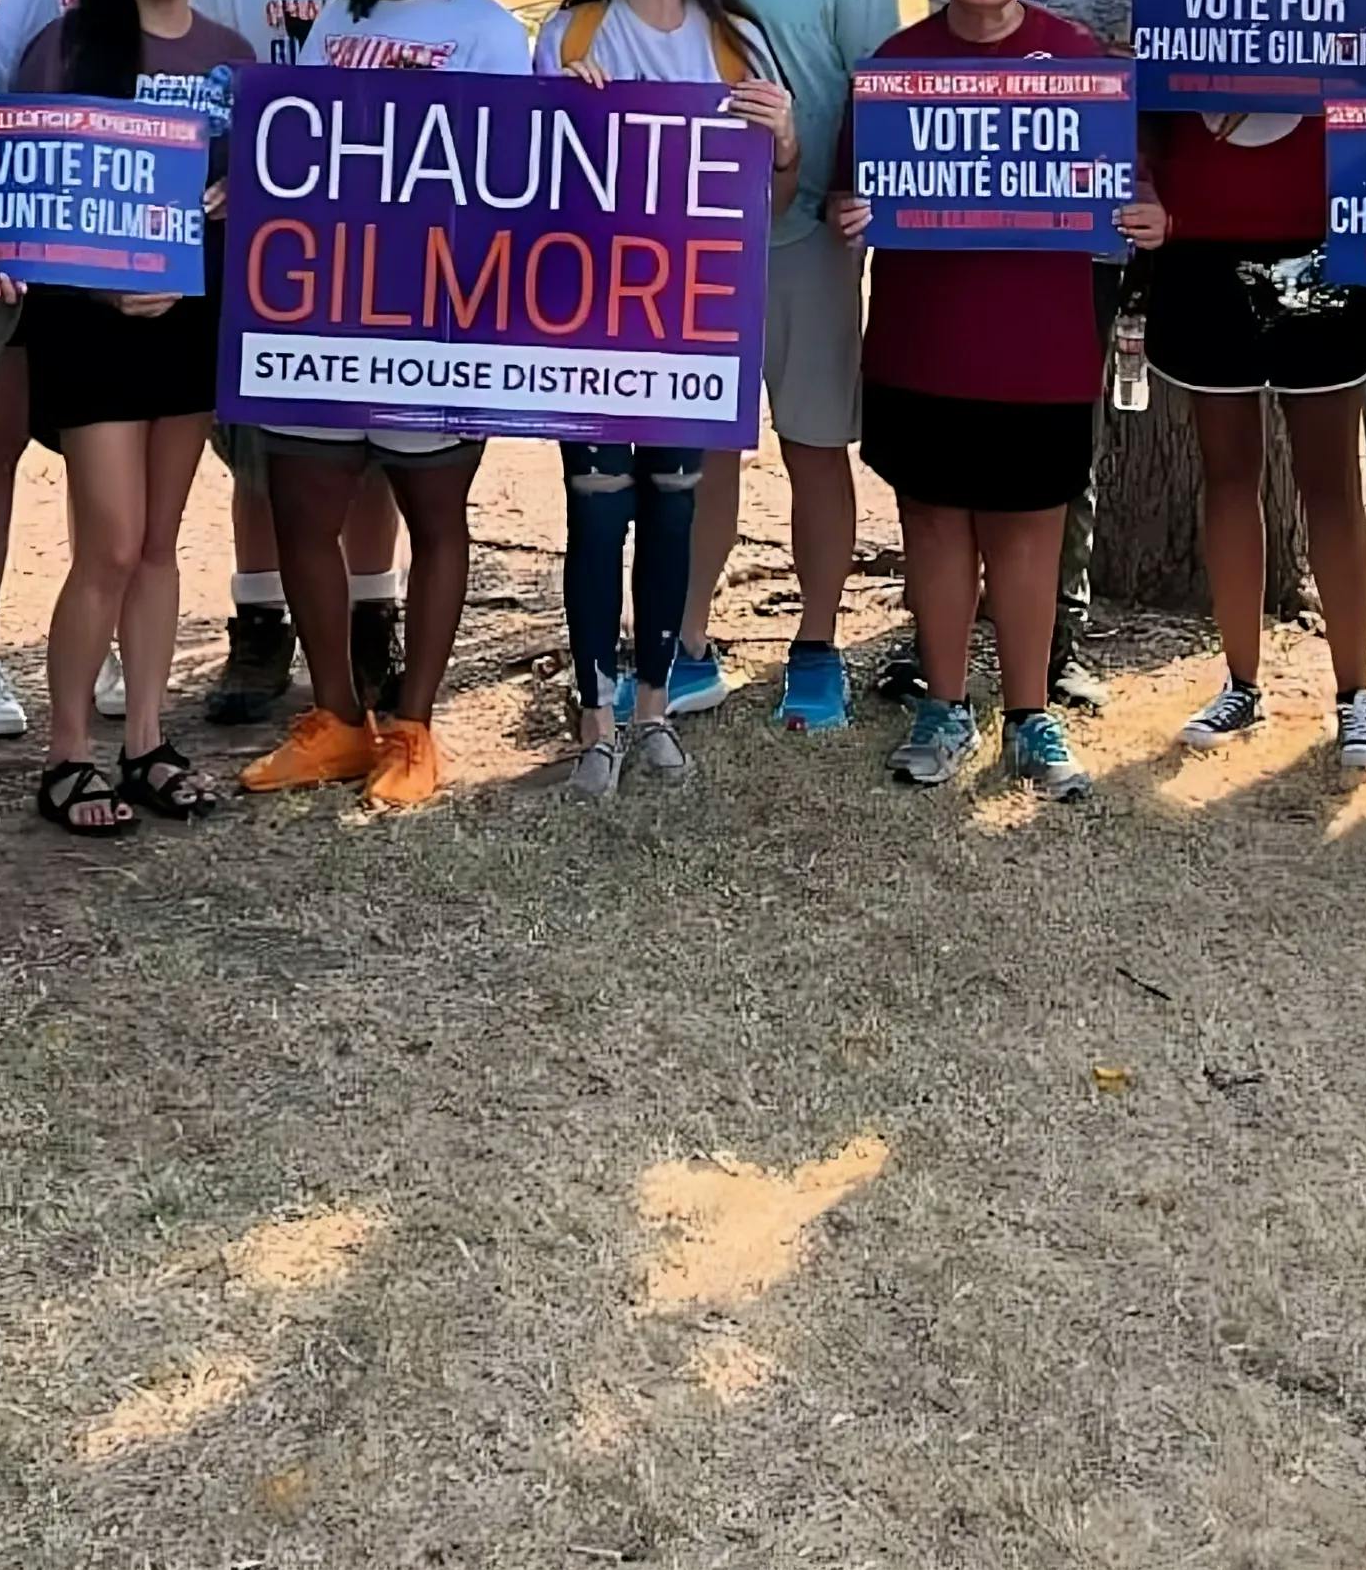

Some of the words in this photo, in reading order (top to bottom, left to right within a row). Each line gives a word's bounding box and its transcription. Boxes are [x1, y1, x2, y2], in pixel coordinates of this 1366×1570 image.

[1135, 23, 1261, 64] CHAUNTÉ
[908, 107, 1001, 152] VOTE
[1012, 107, 1080, 152] FOR
[92, 144, 156, 194] FOR
[858, 155, 992, 197] CHAUNTÉ
[1000, 161, 1133, 199] GILMORE
[80, 197, 202, 245] GILMORE
[247, 218, 744, 342] GILMORE
[254, 351, 360, 385] STATE
[370, 356, 492, 391] HOUSE
[502, 363, 658, 400] DISTRICT
[670, 372, 724, 402] 100
